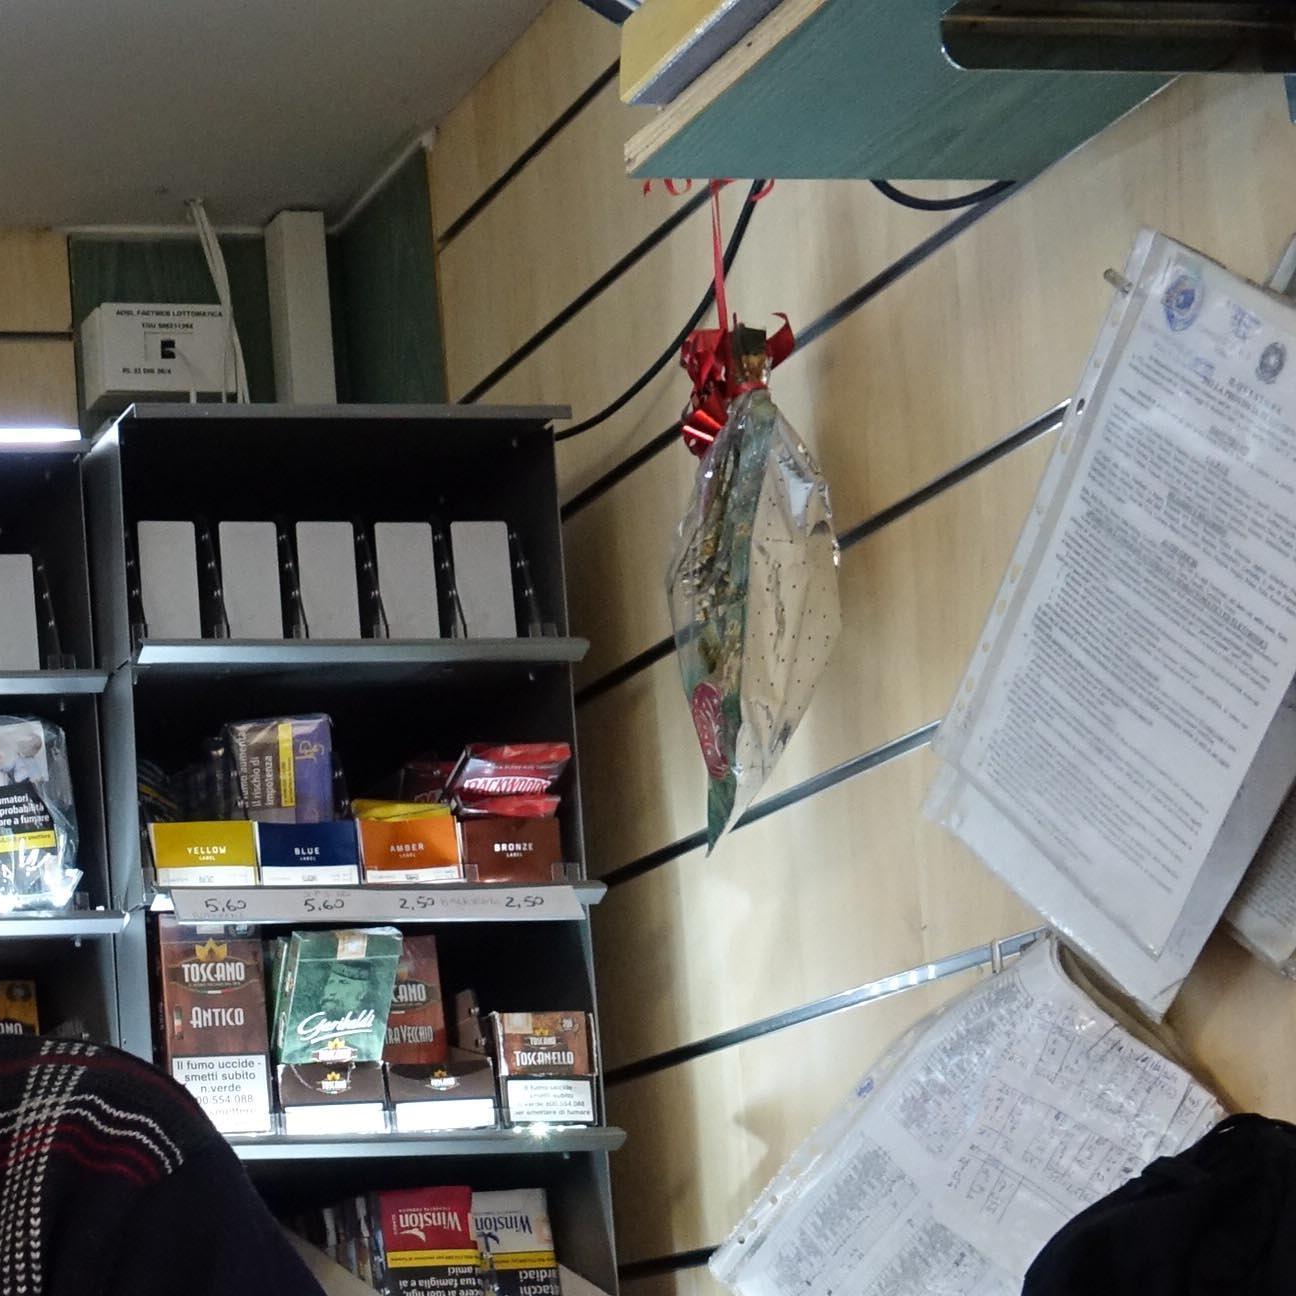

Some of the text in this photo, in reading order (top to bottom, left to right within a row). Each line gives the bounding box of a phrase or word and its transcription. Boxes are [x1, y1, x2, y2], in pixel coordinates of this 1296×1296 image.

[265, 756, 276, 805] impotenza
[187, 846, 227, 854] YELLOW
[294, 847, 320, 855] BLUE
[389, 843, 424, 852] AMBER
[494, 842, 534, 852] BRONZE
[182, 962, 245, 983] TOSCANO
[297, 1009, 376, 1040] Garibaldi
[401, 1025, 434, 1044] VECCHIO
[513, 1051, 574, 1066] TOSCANELLO
[187, 1061, 215, 1070] fumo
[218, 1060, 255, 1069] uccide
[184, 1072, 256, 1082] smetti subito
[399, 1212, 462, 1232] Winston
[475, 1214, 533, 1235] Winston
[447, 1266, 474, 1276] amici
[418, 1276, 458, 1289] famiglia
[459, 1277, 477, 1286] tua
